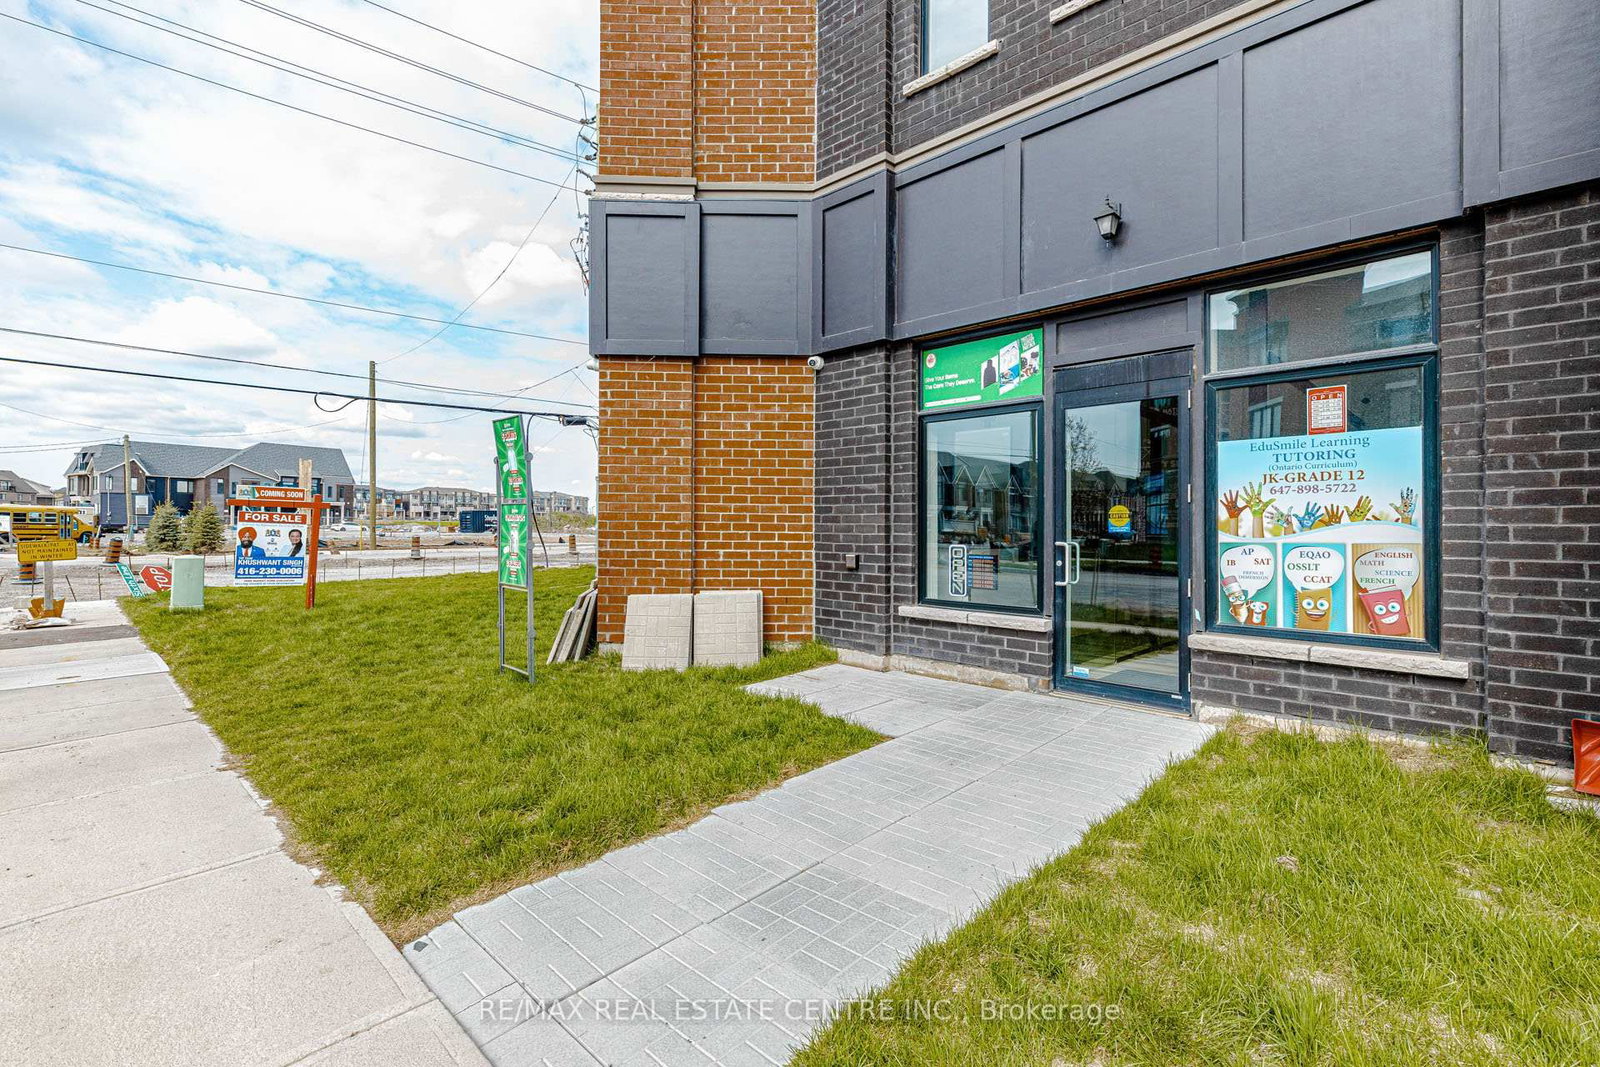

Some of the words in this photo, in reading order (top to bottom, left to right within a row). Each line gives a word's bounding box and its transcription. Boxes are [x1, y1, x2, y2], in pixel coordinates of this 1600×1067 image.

[1311, 392, 1343, 400] OPEN
[1250, 439, 1307, 452] EduSmile
[1311, 436, 1370, 447] Learning
[1272, 449, 1356, 462] TUTORING
[1268, 463, 1303, 472] (Ontario
[1304, 460, 1358, 470] Curriculum)
[1262, 470, 1343, 485] JK-GRADE
[1349, 469, 1365, 480] 12
[1269, 483, 1357, 495] 647-898-5722
[286, 490, 303, 498] SOON
[244, 513, 269, 521] FOR
[272, 514, 302, 523] SALE
[1241, 548, 1254, 556] AP
[1299, 551, 1331, 560] EQAO
[1253, 558, 1272, 566] SAT
[1287, 562, 1320, 571] OSSLT
[1359, 559, 1385, 567] MATH
[237, 567, 302, 575] 416-230-0006
[952, 548, 964, 594] OPEN
[1374, 569, 1413, 577] SCIENCE
[1303, 575, 1333, 584] CCAT
[1359, 577, 1395, 585] FRENCH
